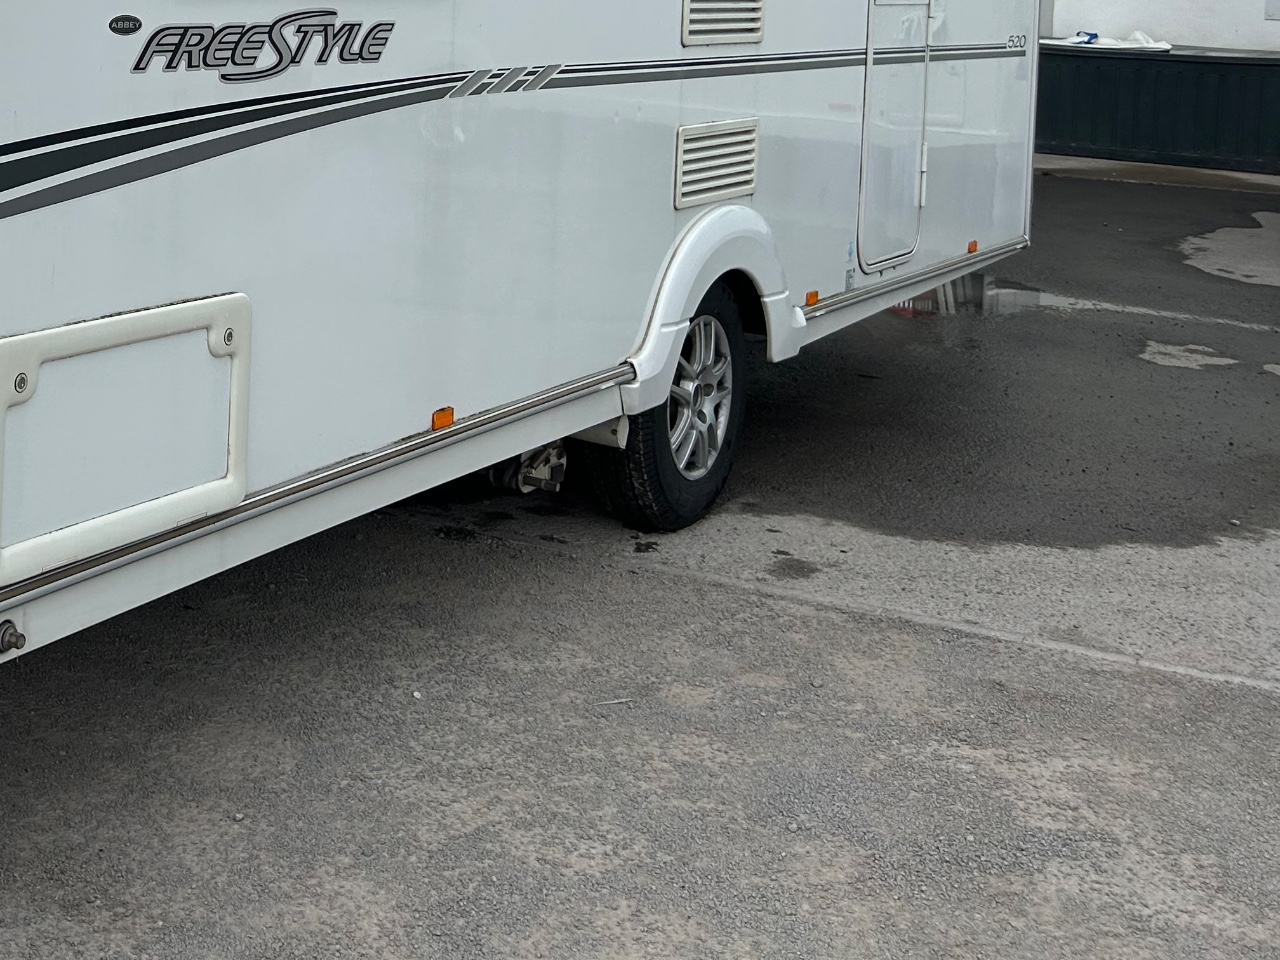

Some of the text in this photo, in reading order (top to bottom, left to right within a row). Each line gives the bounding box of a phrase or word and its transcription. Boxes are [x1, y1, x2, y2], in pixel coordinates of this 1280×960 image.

[111, 8, 396, 84] ABBEY FREESTYLE
[1007, 34, 1027, 49] 520
